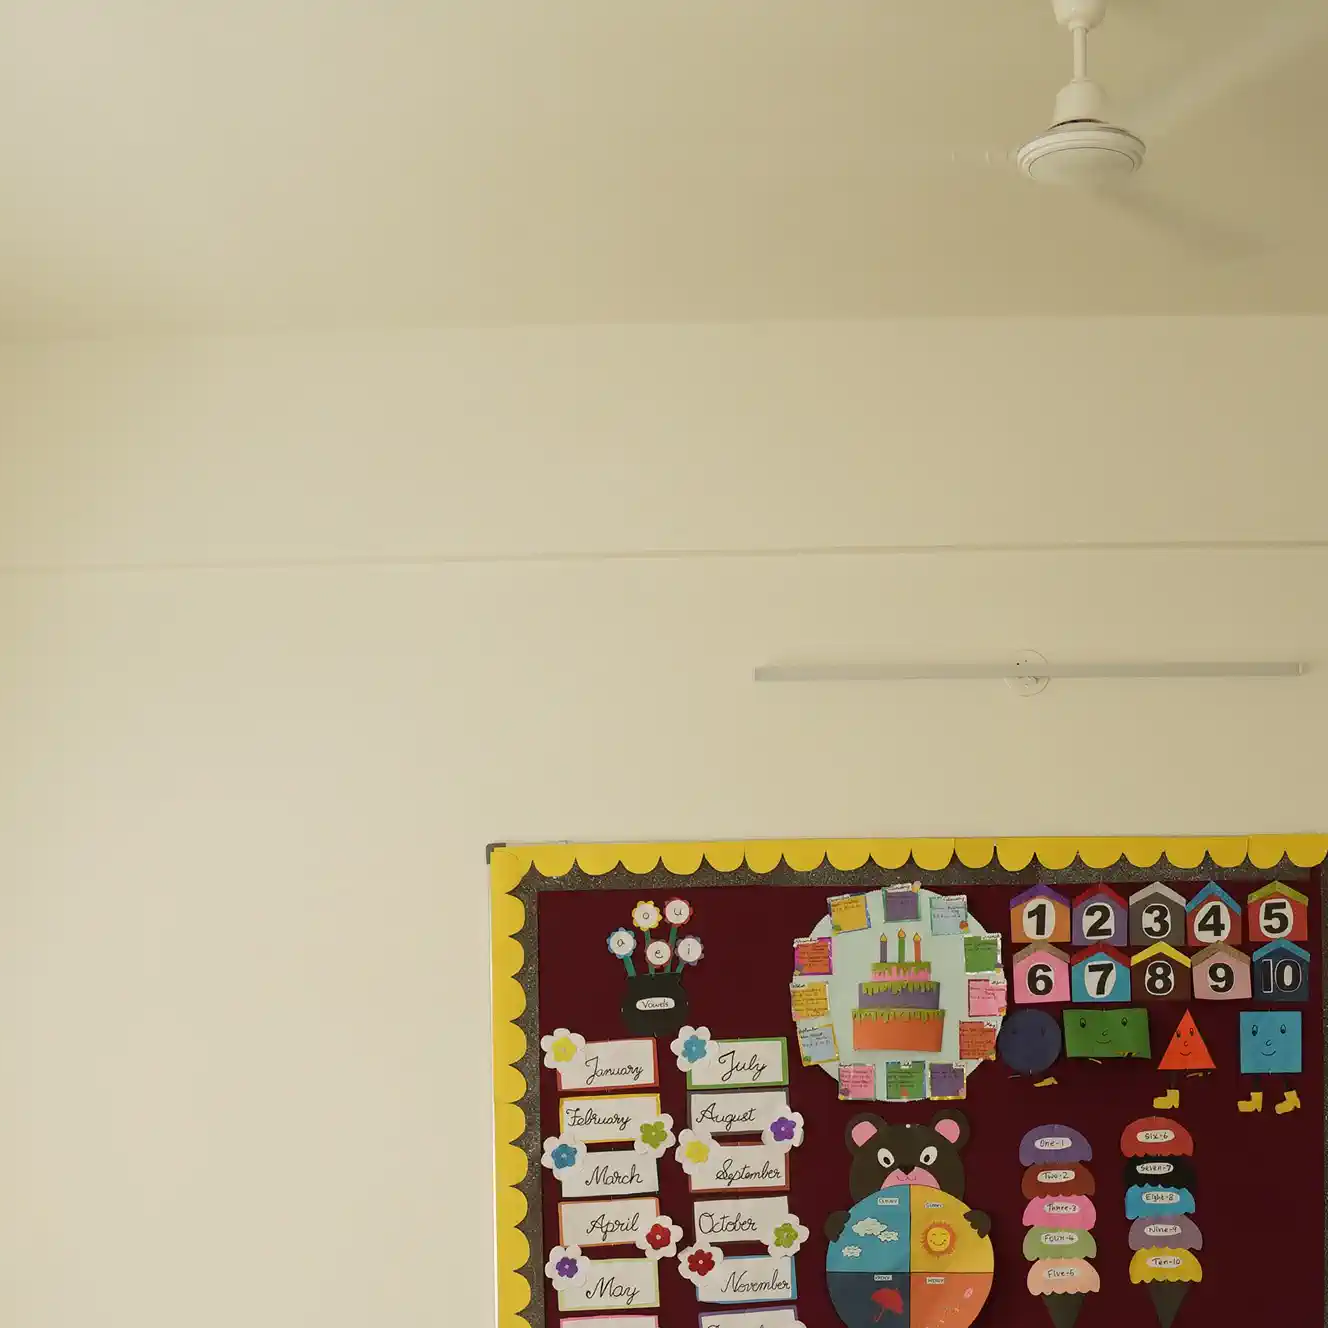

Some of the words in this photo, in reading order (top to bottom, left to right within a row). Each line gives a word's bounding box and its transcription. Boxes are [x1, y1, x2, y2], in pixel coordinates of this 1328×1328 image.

[642, 912, 650, 920] o
[673, 907, 684, 916] u
[1027, 903, 1047, 936] 1
[1085, 905, 1112, 938] 2
[1143, 903, 1170, 937] 3
[1197, 905, 1225, 937] 4
[1263, 901, 1289, 935] 5
[616, 938, 626, 947] a
[654, 948, 664, 959] e
[1027, 964, 1054, 995] 6
[1088, 963, 1114, 995] 7
[1145, 960, 1174, 995] 8
[1208, 962, 1235, 993] 9
[1262, 958, 1302, 994] 10
[641, 998, 670, 1009] Vowels
[585, 1056, 645, 1085] January
[718, 1050, 768, 1082] July
[565, 1107, 632, 1131] February
[695, 1102, 757, 1131] August
[1039, 1138, 1065, 1148] One-1
[585, 1164, 644, 1186] March
[715, 1159, 782, 1187] September
[1041, 1170, 1070, 1180] Two-2
[1046, 1203, 1077, 1213] Three-3
[1145, 1193, 1175, 1203] Eight-8
[586, 1212, 640, 1241] April
[698, 1212, 758, 1235] October
[1147, 1225, 1178, 1234] Nine-9
[1044, 1233, 1075, 1243] Four-4
[1047, 1268, 1075, 1277] Five-5
[1151, 1257, 1182, 1266] Ten-10
[586, 1276, 640, 1305] May
[721, 1269, 790, 1293] November
